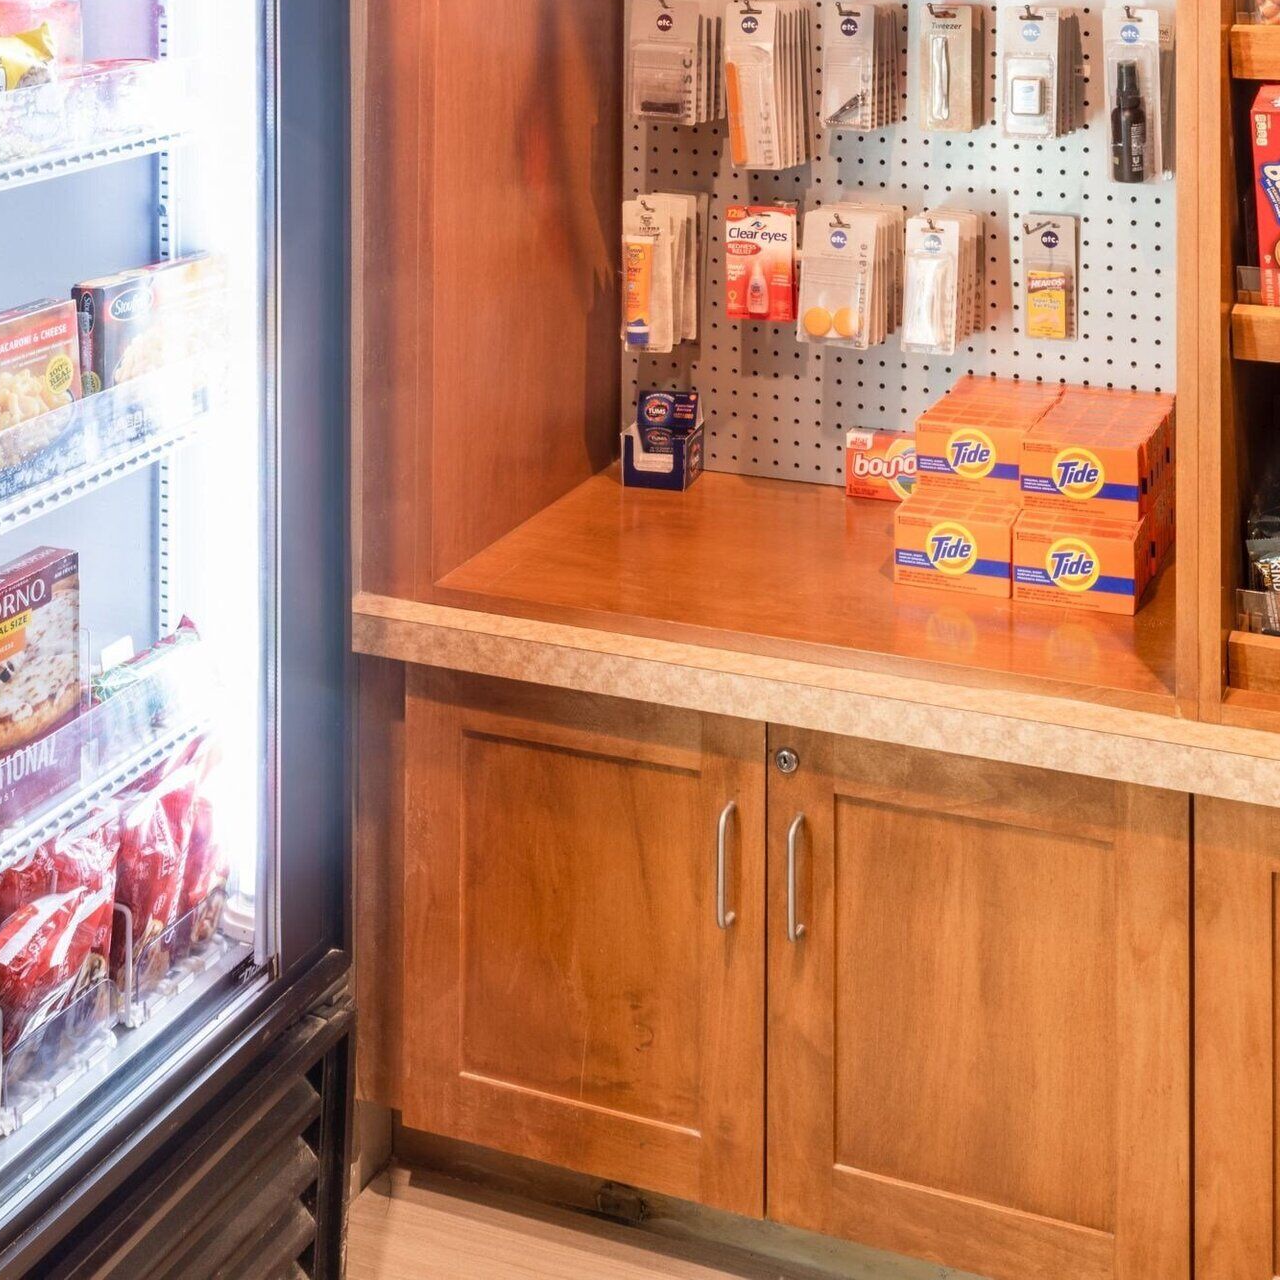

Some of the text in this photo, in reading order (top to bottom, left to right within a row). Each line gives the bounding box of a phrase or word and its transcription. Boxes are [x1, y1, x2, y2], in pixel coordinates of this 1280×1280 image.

[931, 22, 962, 30] Tweezer
[729, 227, 787, 243] Clear eyes
[728, 243, 756, 251] REDNESS
[40, 322, 67, 342] CHEESE
[49, 367, 72, 385] REAL
[647, 406, 666, 415] TUMS
[951, 442, 991, 468] Tide
[1057, 461, 1099, 488] Tide
[931, 536, 972, 563] Tide
[1051, 552, 1094, 580] Tide
[9, 615, 28, 633] SIZE
